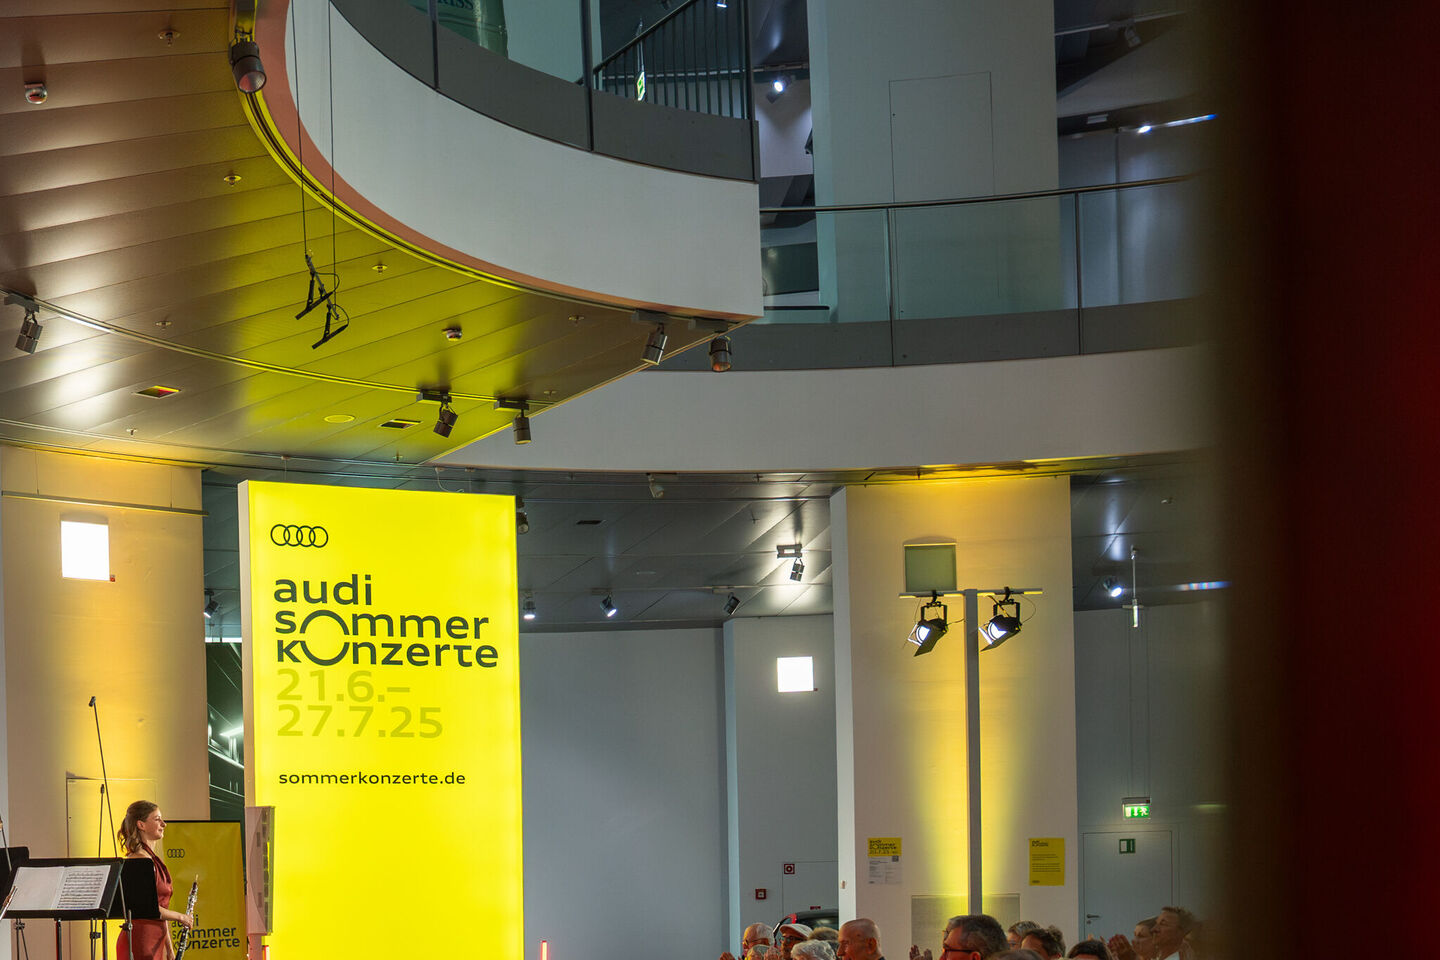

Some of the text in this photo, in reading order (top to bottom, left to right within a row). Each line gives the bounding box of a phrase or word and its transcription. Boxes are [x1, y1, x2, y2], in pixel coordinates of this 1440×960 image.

[273, 574, 372, 606] audi
[275, 609, 489, 640] sommer
[276, 640, 499, 668] konzerte
[276, 704, 443, 738] 27.7.25
[278, 771, 466, 785] sommerkonzerte.de
